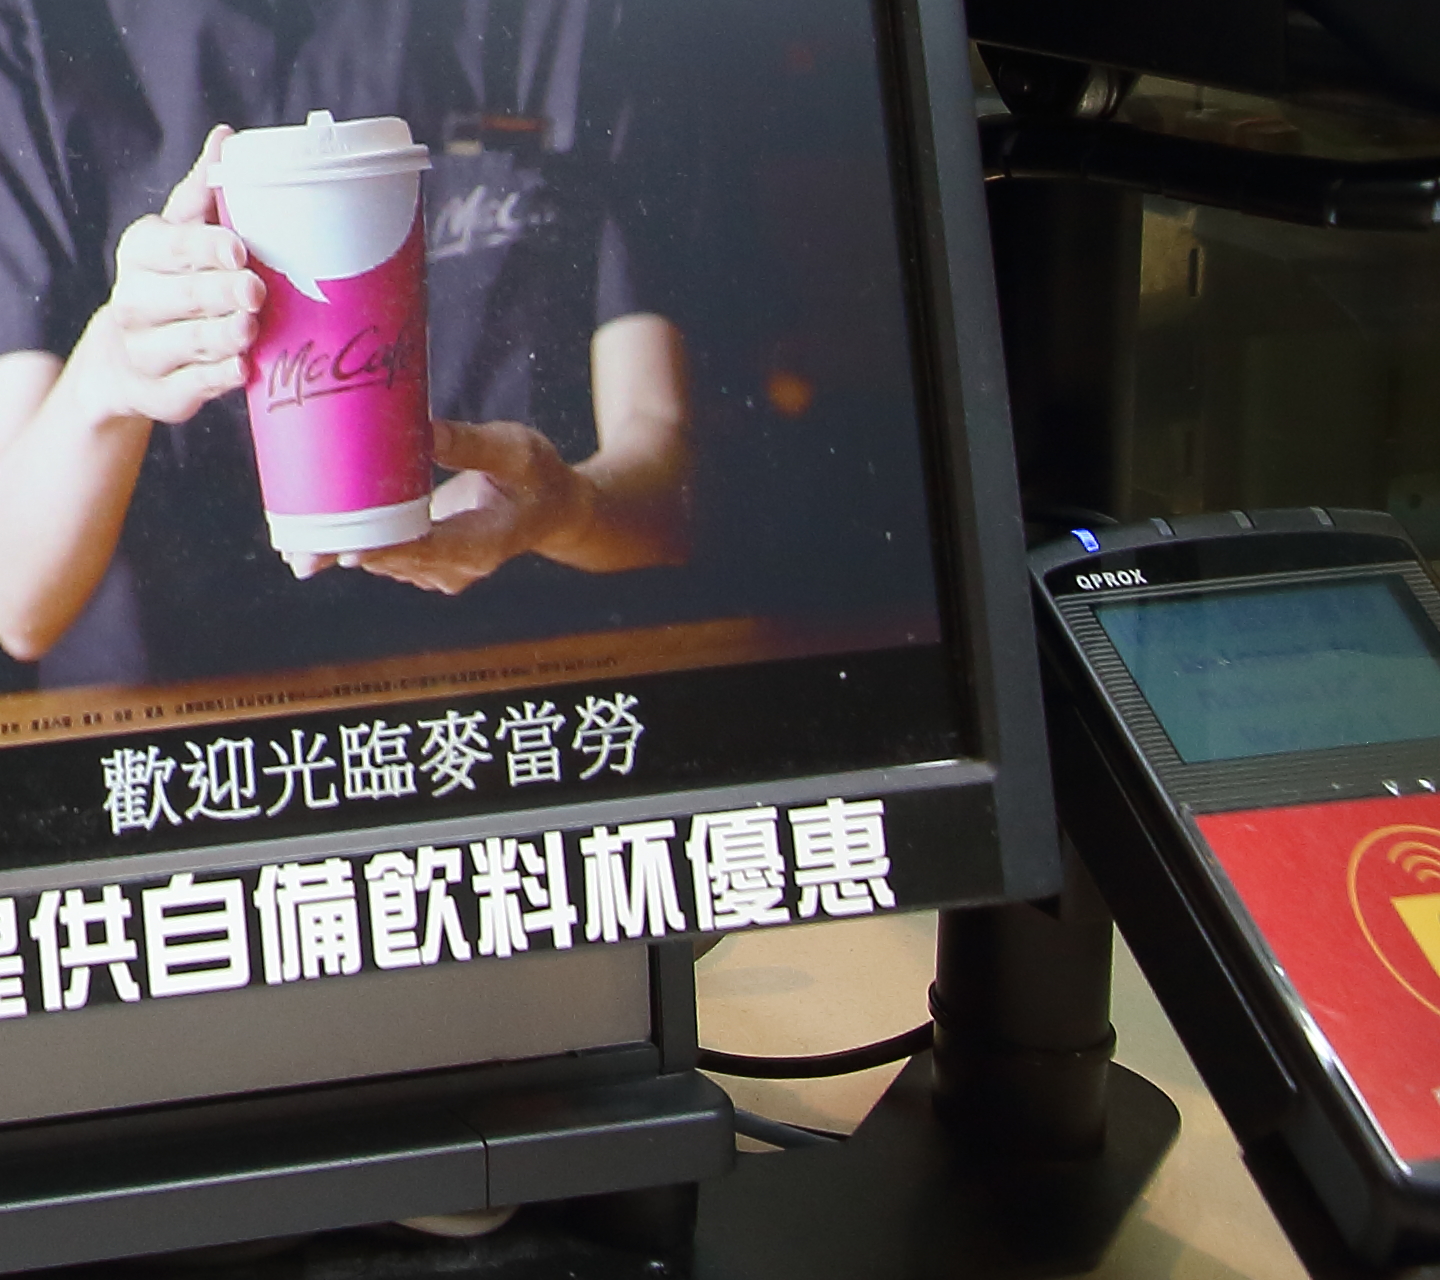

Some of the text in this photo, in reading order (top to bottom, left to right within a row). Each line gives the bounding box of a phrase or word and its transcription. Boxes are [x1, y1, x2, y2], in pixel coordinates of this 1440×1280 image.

[100, 690, 647, 836] 歡迎光臨麥當勞
